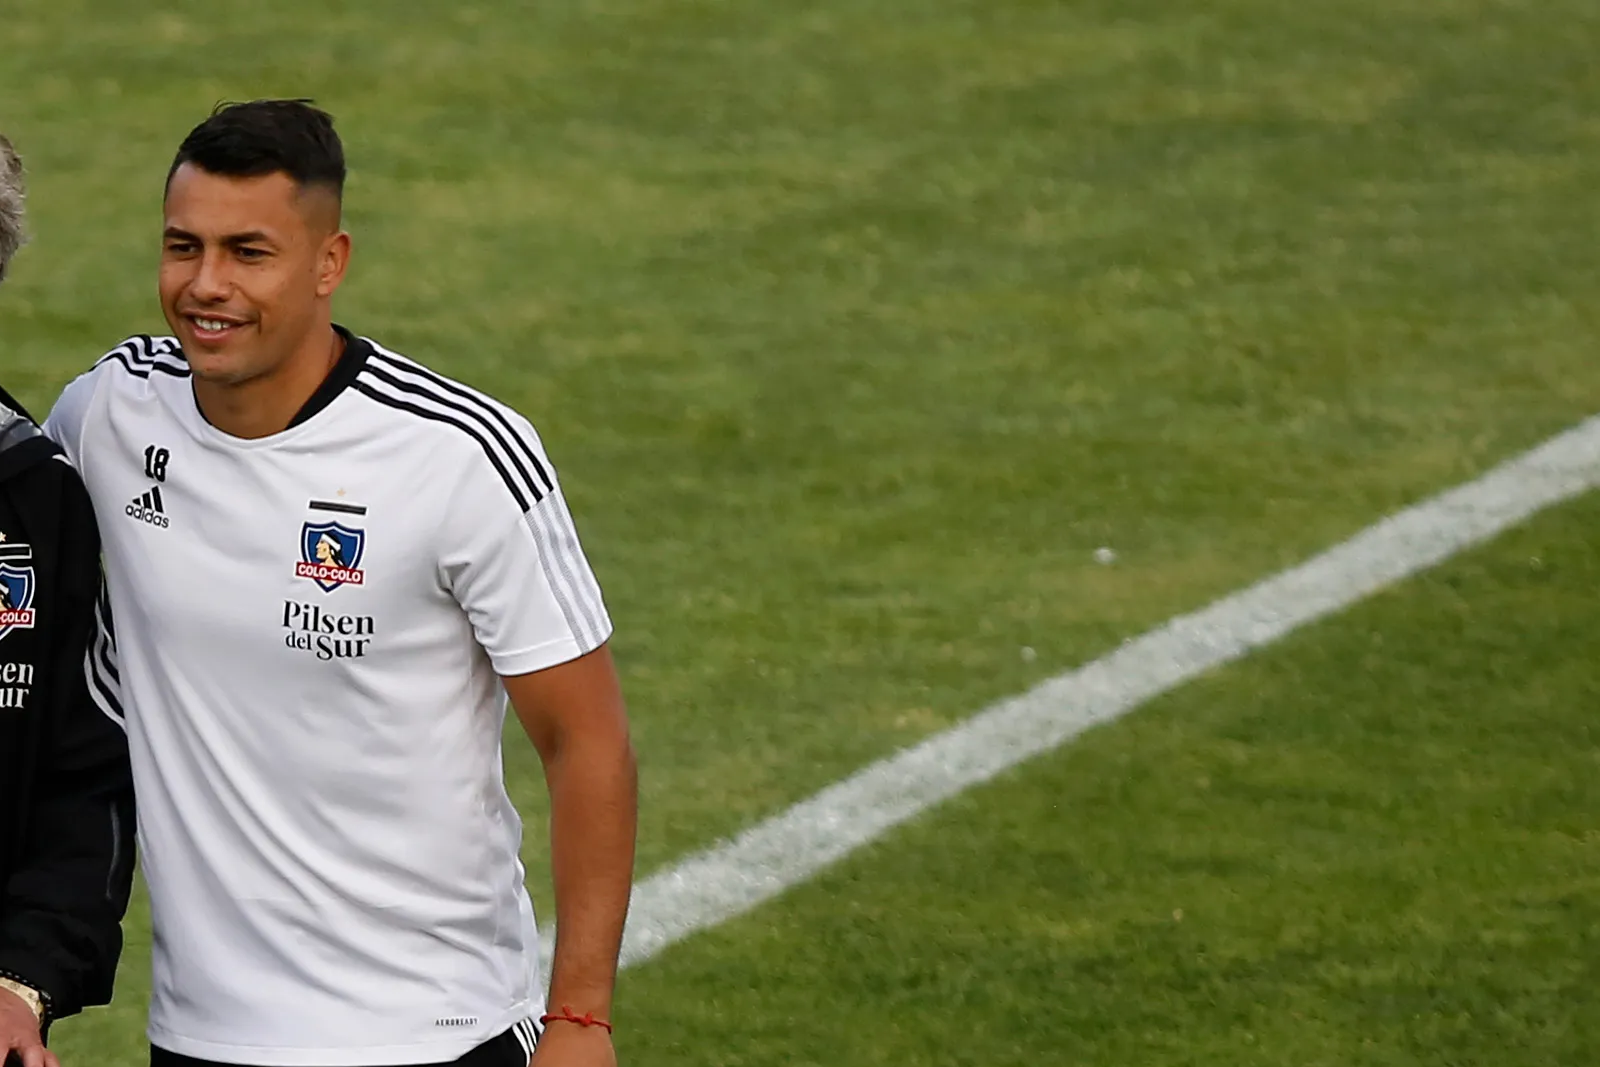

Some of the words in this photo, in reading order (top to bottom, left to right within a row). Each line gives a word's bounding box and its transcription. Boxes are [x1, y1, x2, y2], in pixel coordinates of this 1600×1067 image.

[144, 445, 170, 482] 18
[125, 503, 170, 529] adidas
[297, 563, 362, 583] COLO-COLO
[282, 600, 375, 635] Pilsen
[285, 631, 312, 650] del
[316, 635, 372, 661] Sur
